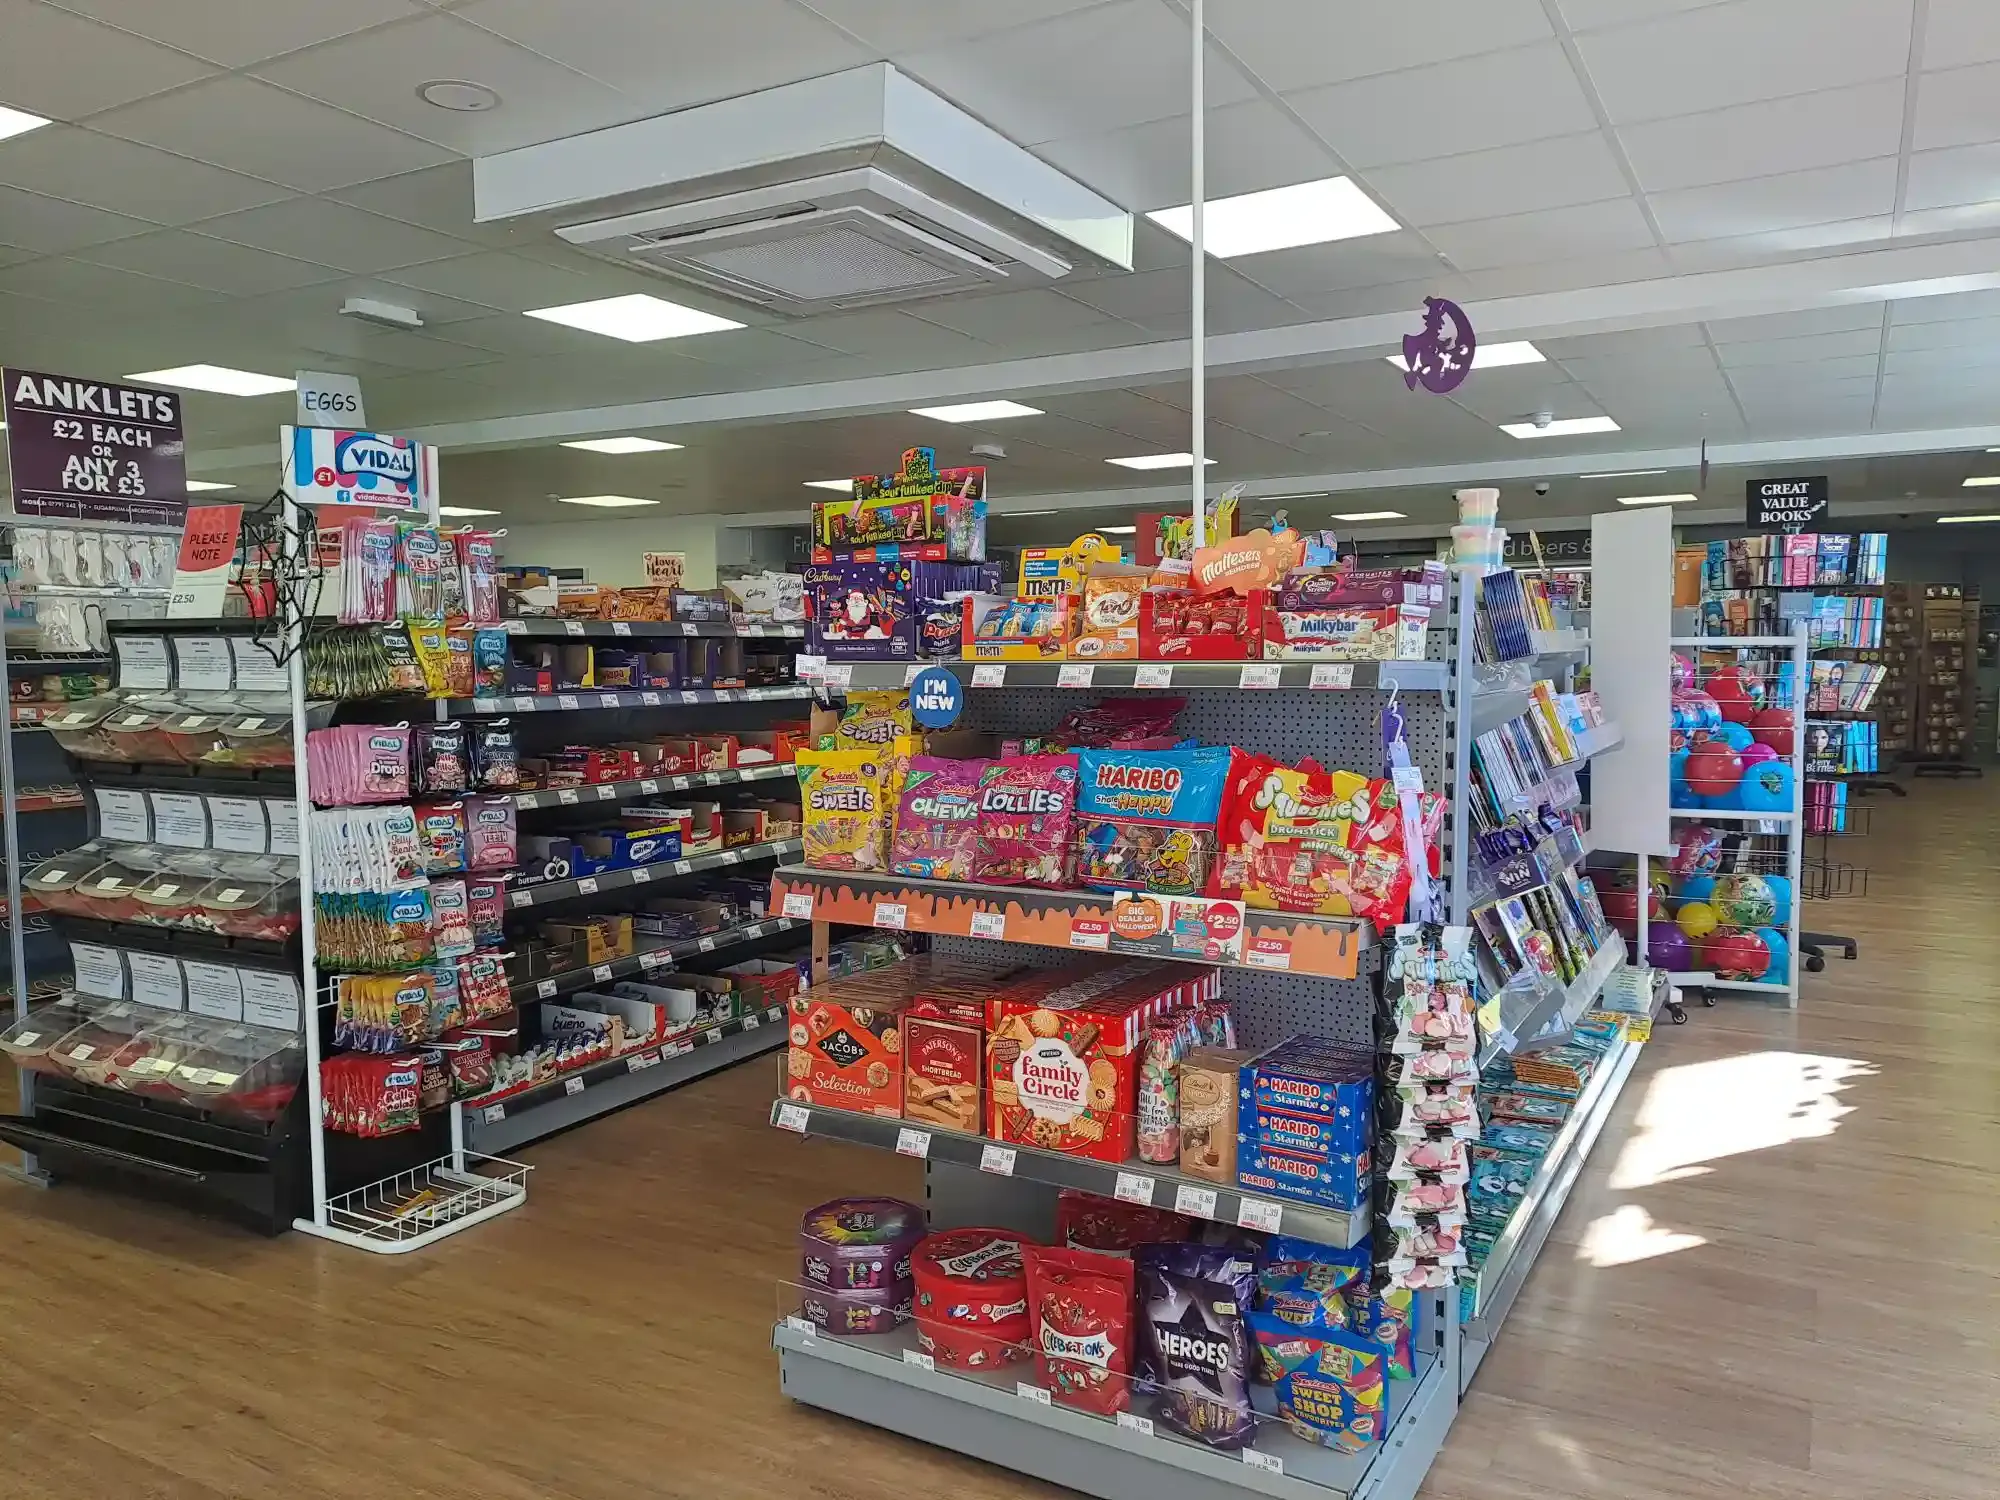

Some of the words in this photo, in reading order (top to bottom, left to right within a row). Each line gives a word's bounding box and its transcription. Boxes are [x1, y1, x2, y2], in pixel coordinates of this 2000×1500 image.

[14, 375, 174, 422] ANKLETS
[305, 391, 357, 411] EGGS
[53, 419, 84, 440] £2
[91, 424, 152, 448] EACH
[91, 445, 113, 457] OR
[65, 455, 118, 476] ANY
[126, 461, 140, 478] 3
[351, 448, 411, 472] VIDAL
[62, 471, 110, 493] FOR
[117, 476, 146, 495] £5
[317, 471, 332, 482] £1
[1761, 483, 1809, 496] GREAT
[1762, 497, 1809, 509] VALUE
[1760, 509, 1812, 523] BOOKS
[189, 532, 229, 544] PLEASE
[192, 549, 220, 560] NOTE
[803, 567, 842, 584] Cadbury
[1201, 551, 1261, 586] Maltesers
[1305, 580, 1336, 588] Quality
[172, 594, 195, 604] £2.50
[1300, 619, 1358, 634] Milkybar
[923, 679, 947, 695] I'M
[915, 695, 955, 711] NEW
[373, 739, 398, 748] VIDAL
[371, 761, 406, 775] Drops
[1097, 765, 1180, 790] HARIBO
[810, 787, 875, 812] SWEETS
[982, 788, 1065, 814] LOLLIES
[1095, 795, 1118, 804] Share
[1118, 794, 1172, 815] Happy
[1270, 824, 1336, 837] DRUMSTICK
[1300, 841, 1328, 851] MINI
[395, 907, 420, 916] VIDAL
[1128, 907, 1145, 915] BIG
[1079, 922, 1102, 932] £2.50
[1116, 922, 1157, 931] HALLOWEEN
[1208, 914, 1239, 930] £2.50
[1257, 941, 1283, 951] £2.50
[949, 1008, 984, 1018] SHORTBREAD
[552, 1016, 585, 1030] bueno
[821, 1041, 865, 1056] JACOB'S
[921, 1039, 963, 1064] PATERSON'S
[921, 1064, 962, 1079] SHORTBREAD
[1023, 1056, 1083, 1087] family
[813, 1071, 871, 1096] Selection
[1023, 1078, 1080, 1101] Circle
[1271, 1078, 1320, 1098] HARIBO
[1270, 1117, 1319, 1137] HARIBO
[1268, 1156, 1318, 1178] HARIBO
[1240, 1173, 1276, 1189] HARIBO
[805, 1256, 831, 1275] Quality
[804, 1300, 828, 1317] Quality
[808, 1311, 827, 1326] Street
[1156, 1328, 1229, 1369] HEROES
[1184, 1363, 1200, 1373] GOOD
[1292, 1385, 1342, 1404] SWEET
[1293, 1397, 1343, 1419] SHOP
